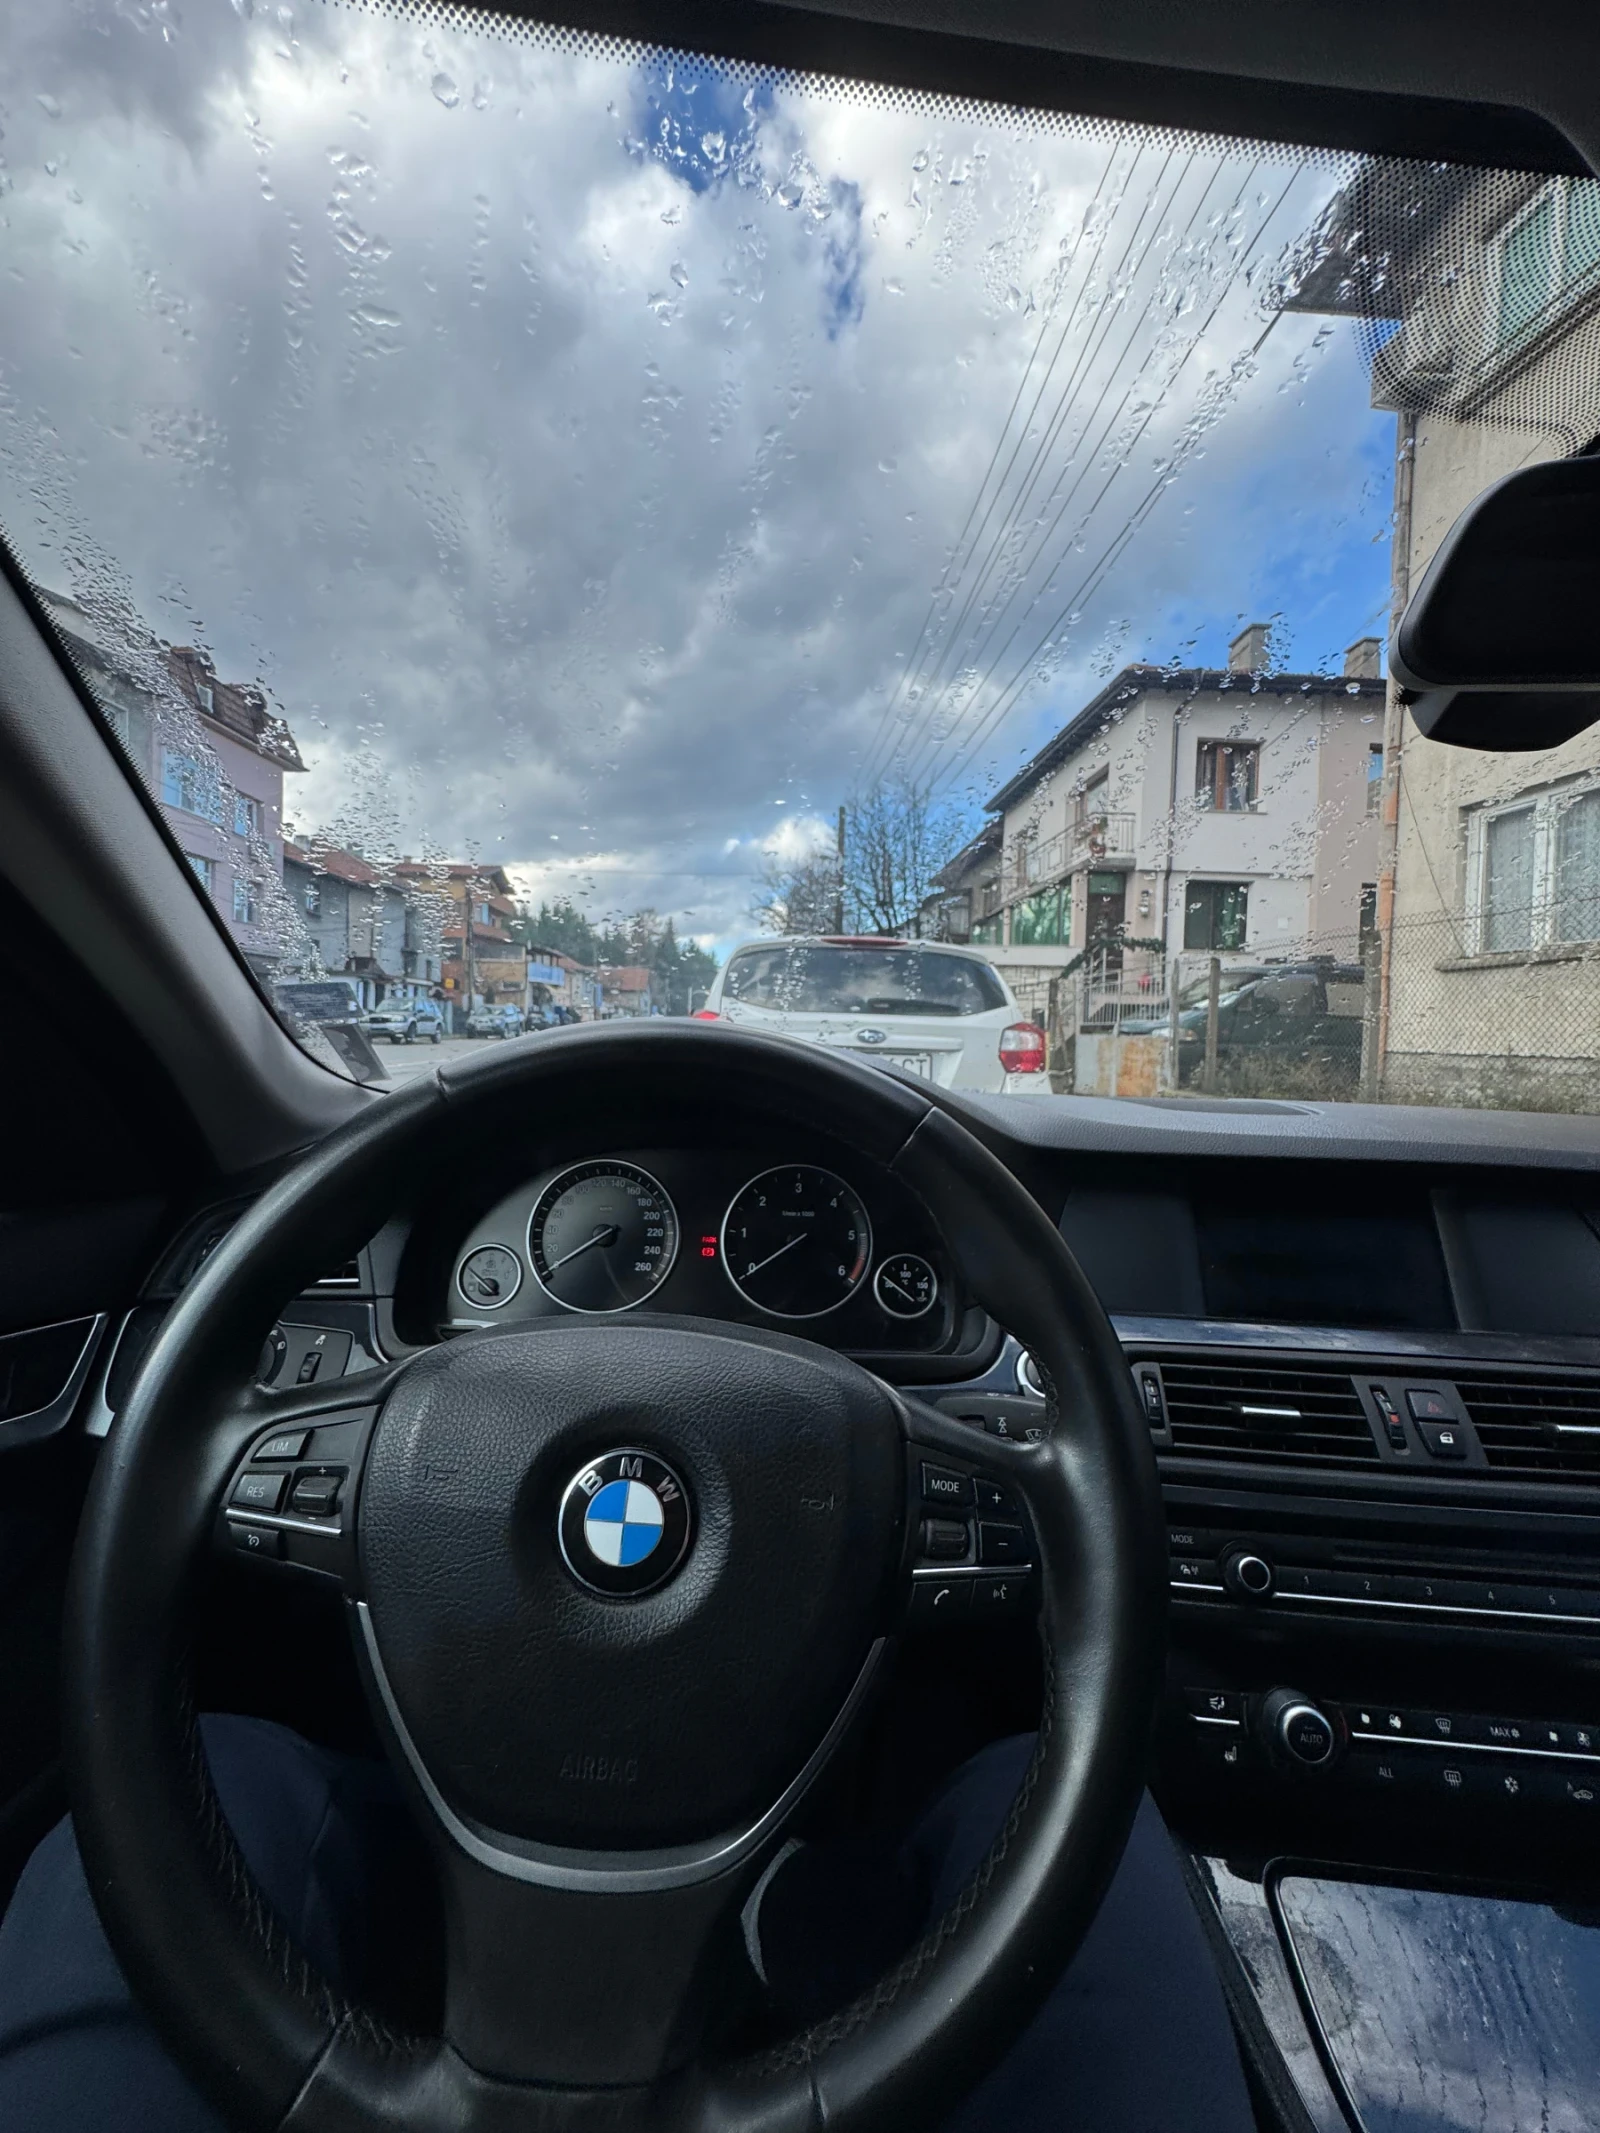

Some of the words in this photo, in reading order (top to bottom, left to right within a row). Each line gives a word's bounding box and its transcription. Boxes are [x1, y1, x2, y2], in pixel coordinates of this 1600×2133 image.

[611, 1180, 626, 1188] 140
[795, 1183, 802, 1193] 3
[626, 1187, 641, 1195] 160
[637, 1198, 652, 1206] 180
[759, 1196, 767, 1206] 2
[830, 1198, 838, 1208] 4
[643, 1211, 660, 1220] 200
[647, 1228, 664, 1237] 220
[741, 1227, 747, 1238] 1
[848, 1230, 855, 1240] 5
[547, 1244, 558, 1252] 20
[644, 1246, 661, 1255] 240
[634, 1262, 652, 1271] 260
[748, 1262, 756, 1273] 0
[838, 1265, 846, 1276] 6
[272, 1441, 289, 1452] LIM
[578, 1456, 681, 1503] BMW
[931, 1479, 960, 1493] MODE
[246, 1485, 265, 1498] RES
[1171, 1534, 1195, 1545] MODE
[1304, 1576, 1310, 1585] 1
[1364, 1581, 1371, 1591] 2
[1426, 1586, 1433, 1596] 3
[1488, 1591, 1495, 1600] 4
[1548, 1594, 1556, 1605] 5
[1489, 1726, 1511, 1738] MAX
[1300, 1732, 1323, 1745] AUTO
[559, 1754, 639, 1783] AIRBAG
[1379, 1766, 1394, 1779] ALL
